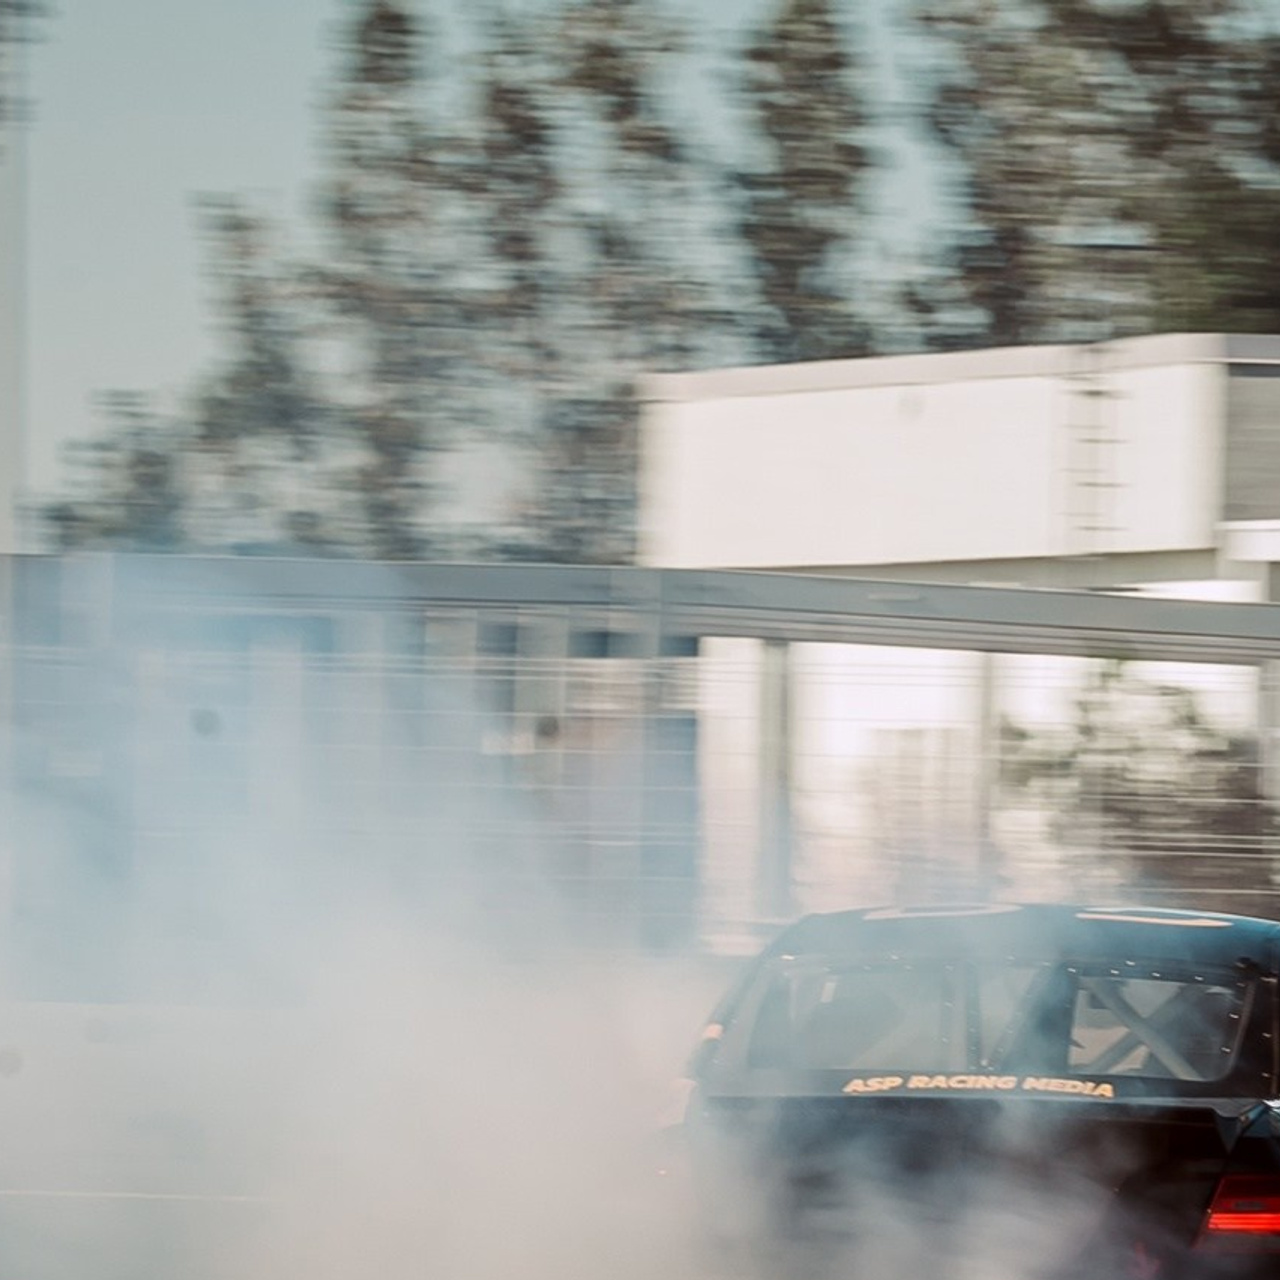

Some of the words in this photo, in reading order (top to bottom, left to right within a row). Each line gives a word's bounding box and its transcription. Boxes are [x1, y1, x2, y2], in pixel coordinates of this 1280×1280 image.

[842, 1077, 903, 1094] ASP
[906, 1074, 1018, 1090] RACING
[1022, 1076, 1114, 1099] MEDIA
